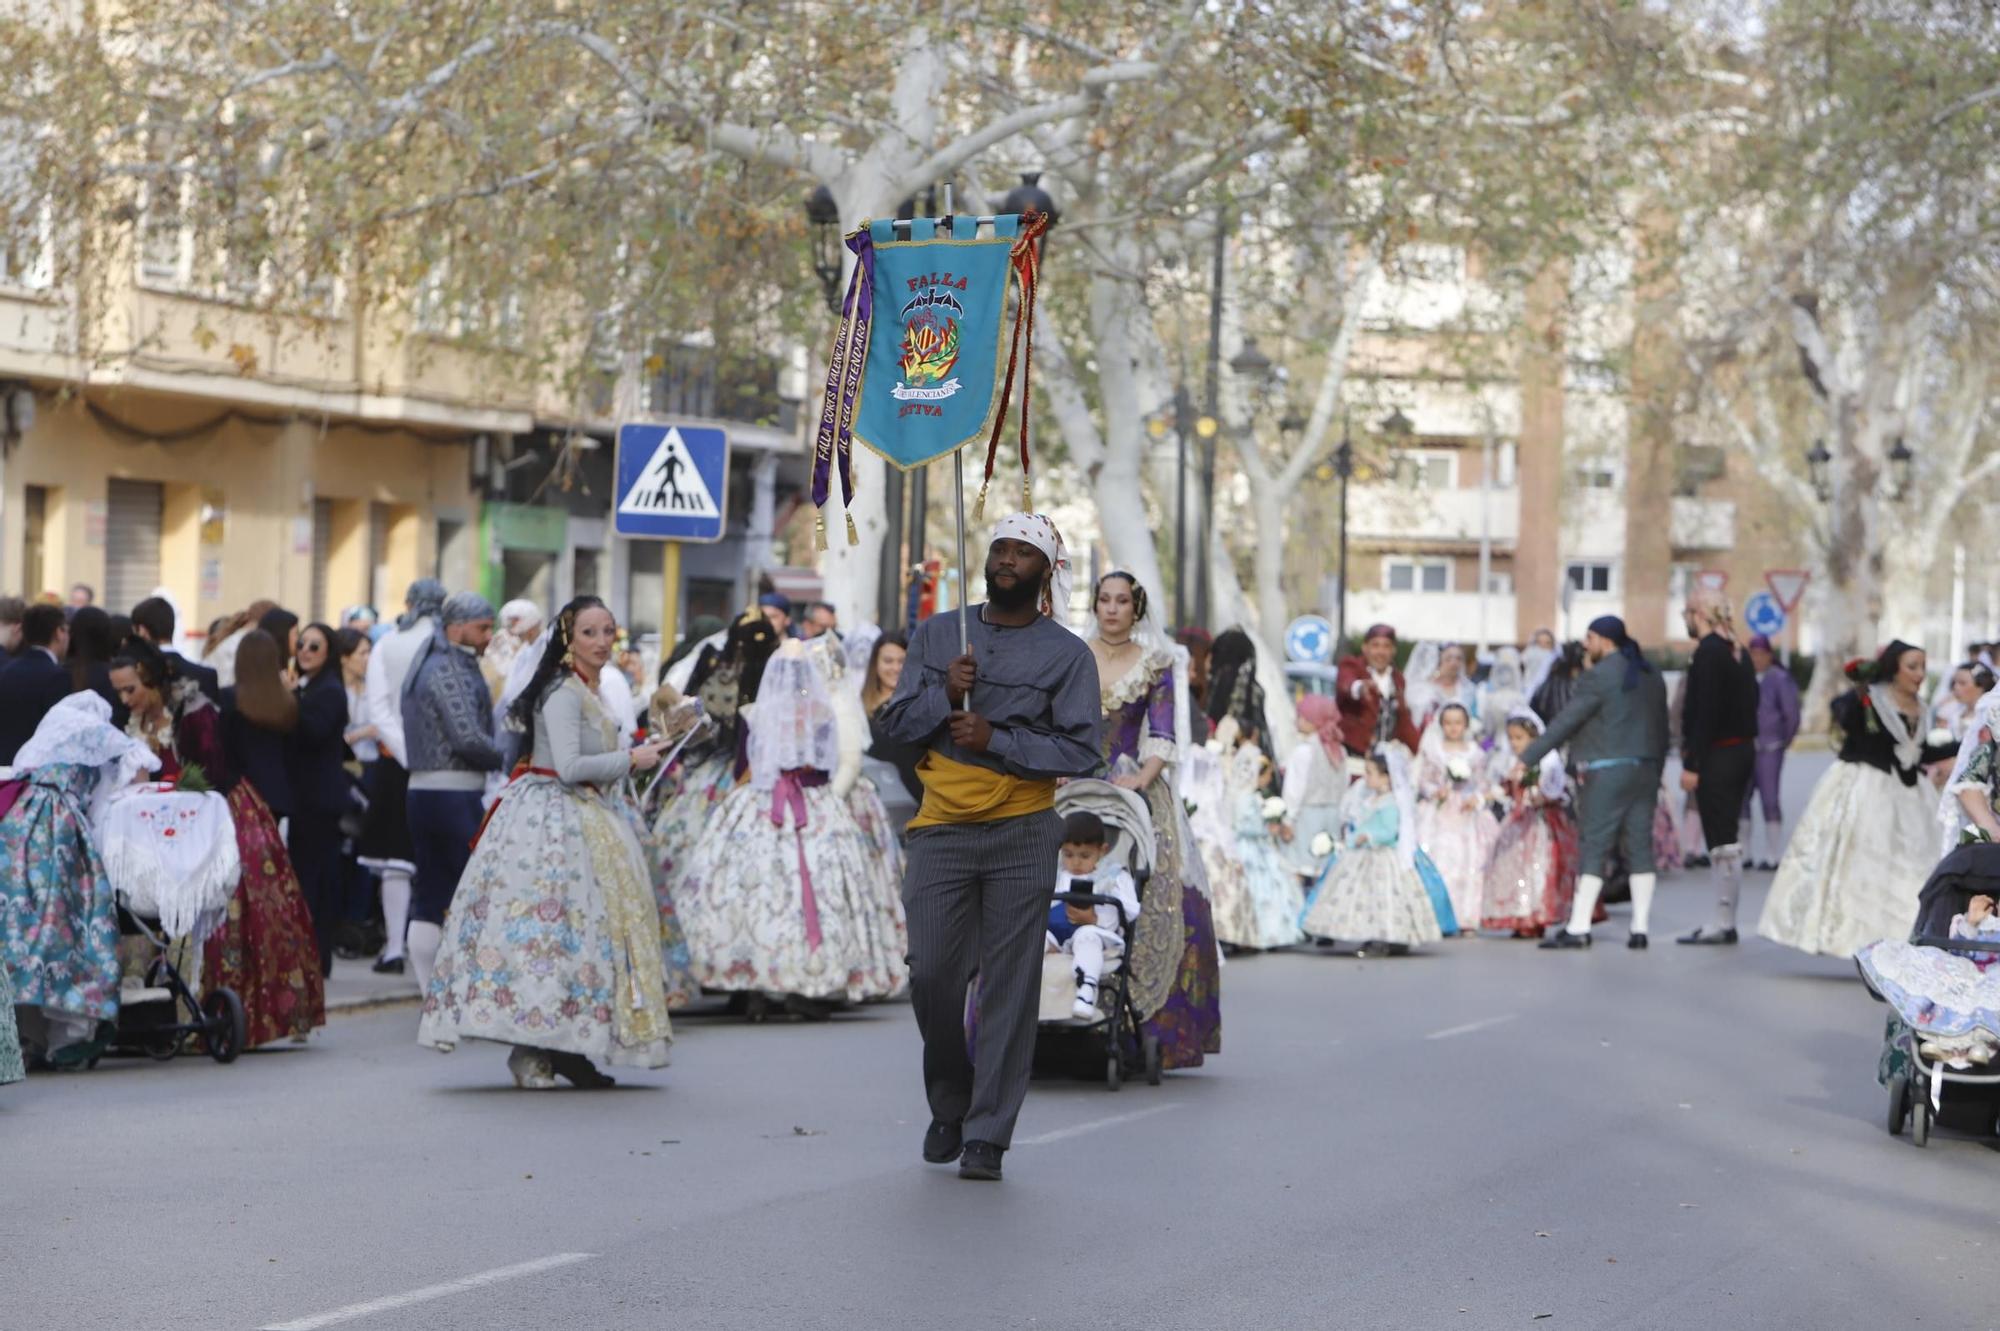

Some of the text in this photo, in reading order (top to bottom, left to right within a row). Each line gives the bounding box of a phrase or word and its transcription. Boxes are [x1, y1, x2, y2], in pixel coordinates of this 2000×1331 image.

[907, 272, 967, 291] FALLA
[818, 318, 848, 461] FALLA CORTS VALENCIANES
[839, 320, 866, 455] AL SEU ESTENDARD
